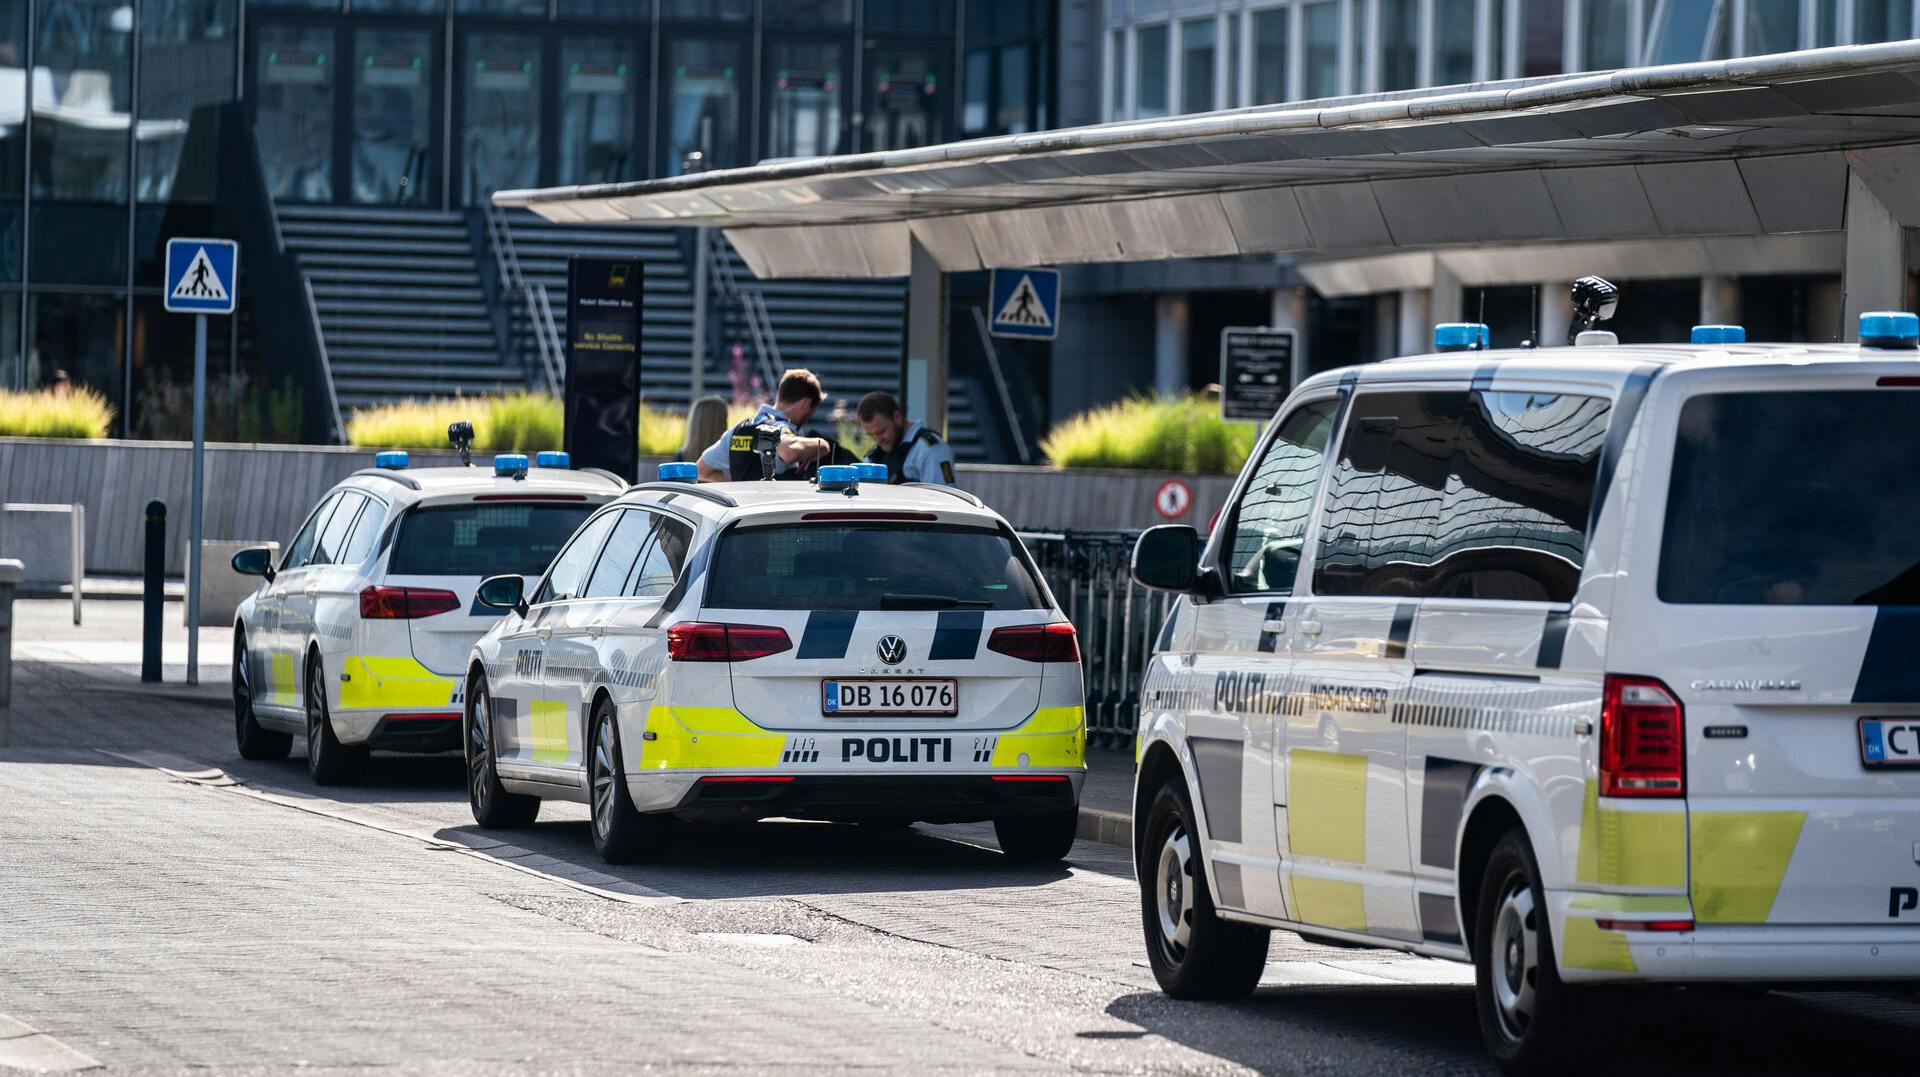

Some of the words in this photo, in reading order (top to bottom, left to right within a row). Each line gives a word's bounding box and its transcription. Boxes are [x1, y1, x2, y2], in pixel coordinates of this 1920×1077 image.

[621, 299, 634, 307] Bus
[515, 649, 543, 680] POLITI
[841, 685, 872, 706] DB
[880, 685, 905, 706] 16
[911, 685, 952, 706] 076
[1213, 671, 1266, 714] POLITI
[1309, 683, 1388, 714] INDSATSLEDER
[1690, 679, 1801, 691] CARAVELLE
[842, 738, 952, 762] POLITI
[1868, 745, 1881, 754] DK
